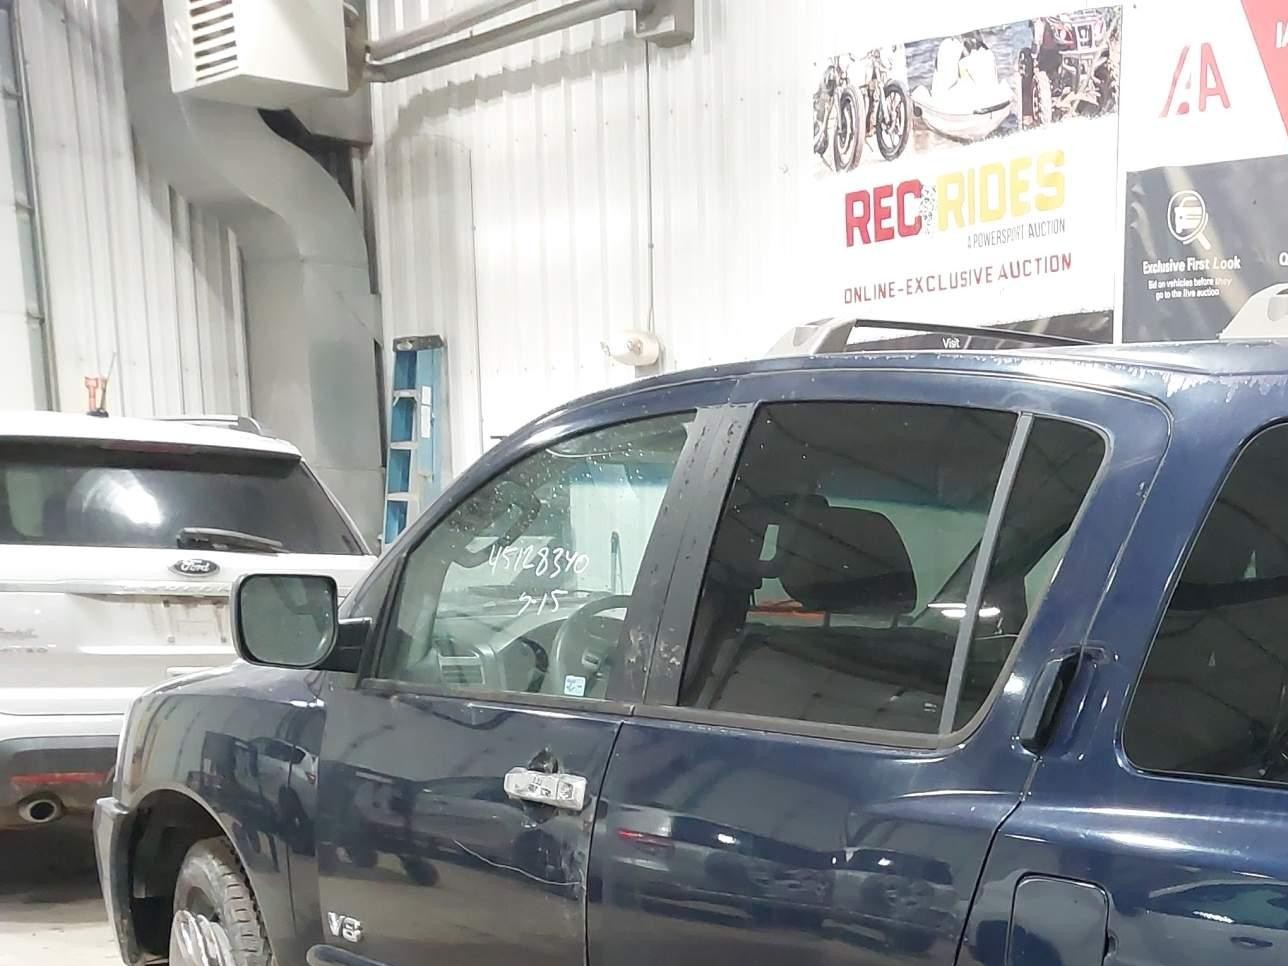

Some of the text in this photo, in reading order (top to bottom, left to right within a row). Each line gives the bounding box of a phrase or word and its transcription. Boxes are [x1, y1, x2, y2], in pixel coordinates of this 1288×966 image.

[845, 150, 1066, 248] REC RIDES
[1028, 218, 1066, 239] AUCTION
[1142, 255, 1241, 275] Exclusive First Look
[844, 252, 1072, 304] ONLINE-EXCLUSIVE AUCTION
[1166, 278, 1194, 288] vehicles
[1193, 276, 1214, 287] before
[1171, 289, 1183, 298] the
[488, 543, 590, 580] 45128340
